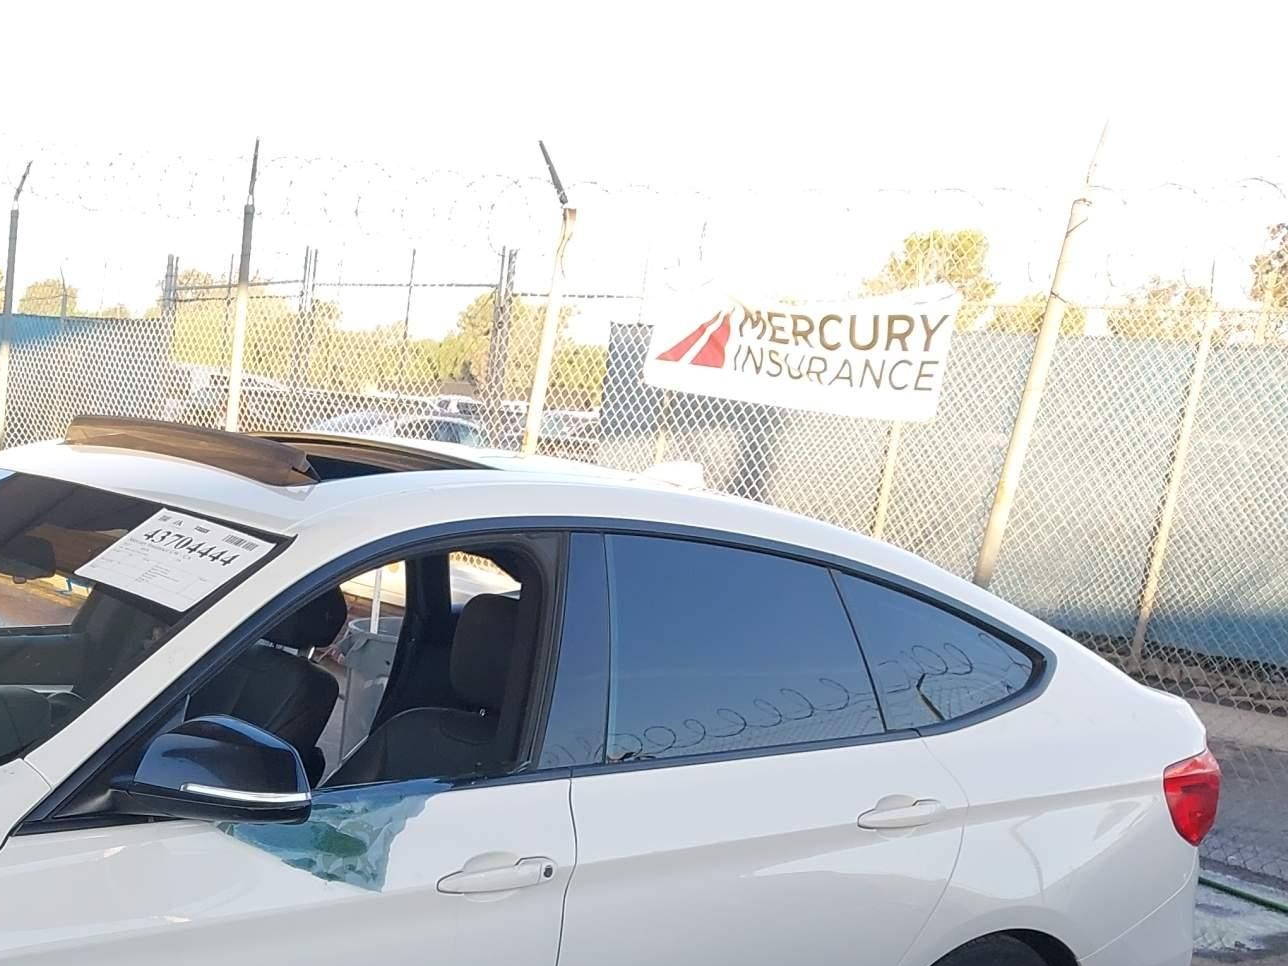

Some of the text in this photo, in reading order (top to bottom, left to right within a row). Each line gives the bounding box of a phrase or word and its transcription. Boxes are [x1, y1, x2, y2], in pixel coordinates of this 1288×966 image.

[738, 304, 950, 352] MERCURY
[733, 344, 940, 392] INSURANCE
[144, 528, 241, 567] 43704444
